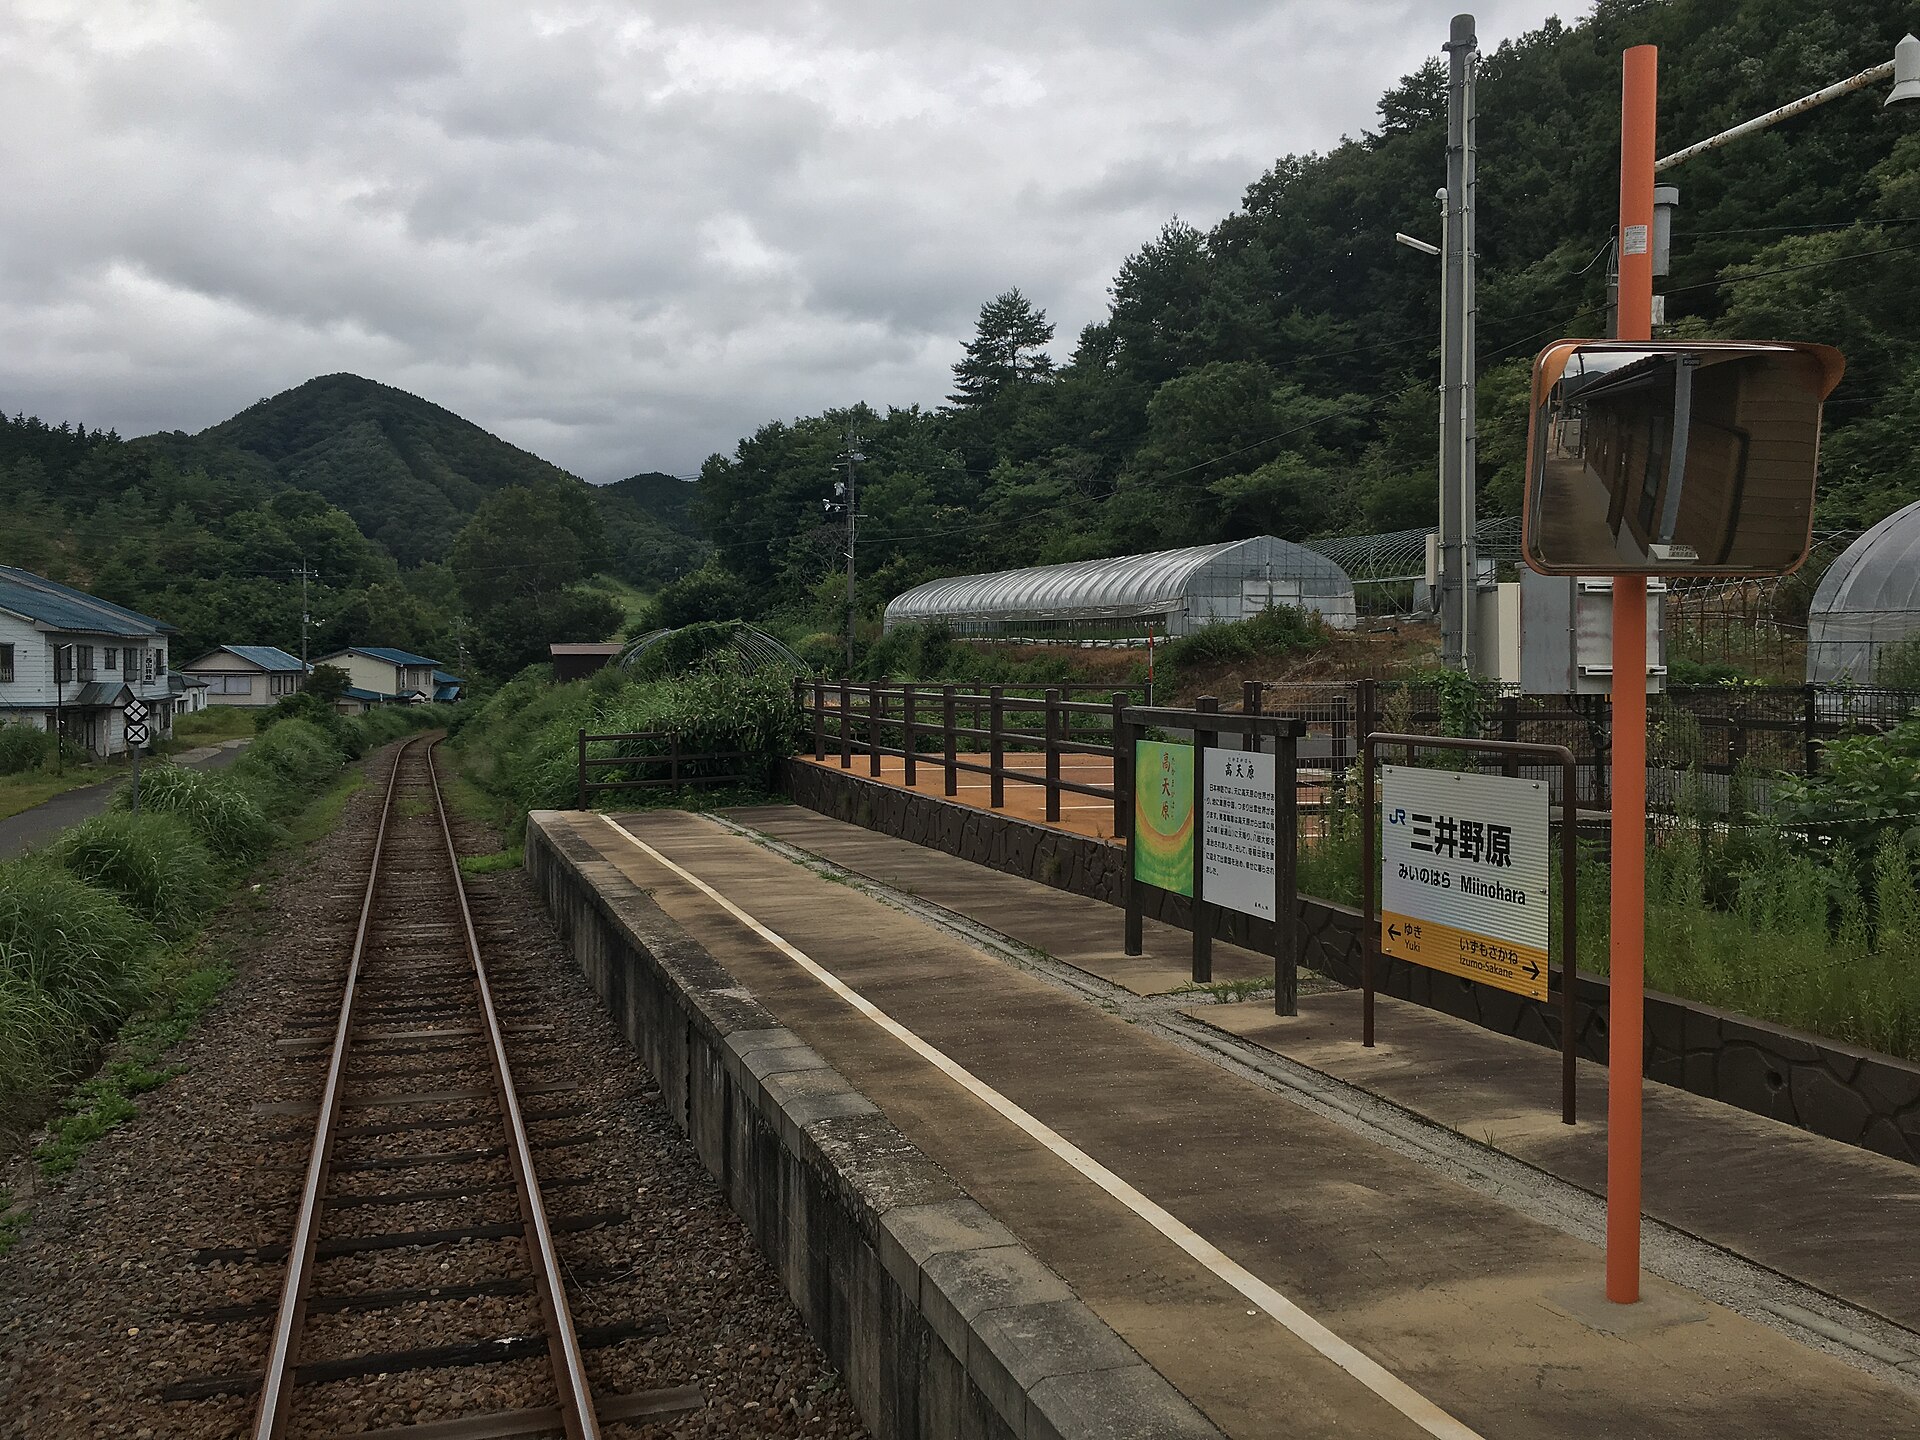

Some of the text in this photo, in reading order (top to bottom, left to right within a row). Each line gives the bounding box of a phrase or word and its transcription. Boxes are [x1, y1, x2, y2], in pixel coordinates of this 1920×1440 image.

[1225, 762, 1255, 780] 高天原
[1162, 752, 1171, 820] 高天原
[1389, 808, 1406, 825] JR
[1410, 813, 1512, 868] 三井野原
[1398, 863, 1526, 906] みいのはら Miinohara
[1404, 922, 1423, 940] ゆき
[1404, 940, 1421, 953] Yuki
[1459, 937, 1518, 965] いずもさかね
[1459, 954, 1513, 979] Izumo-Sakane
